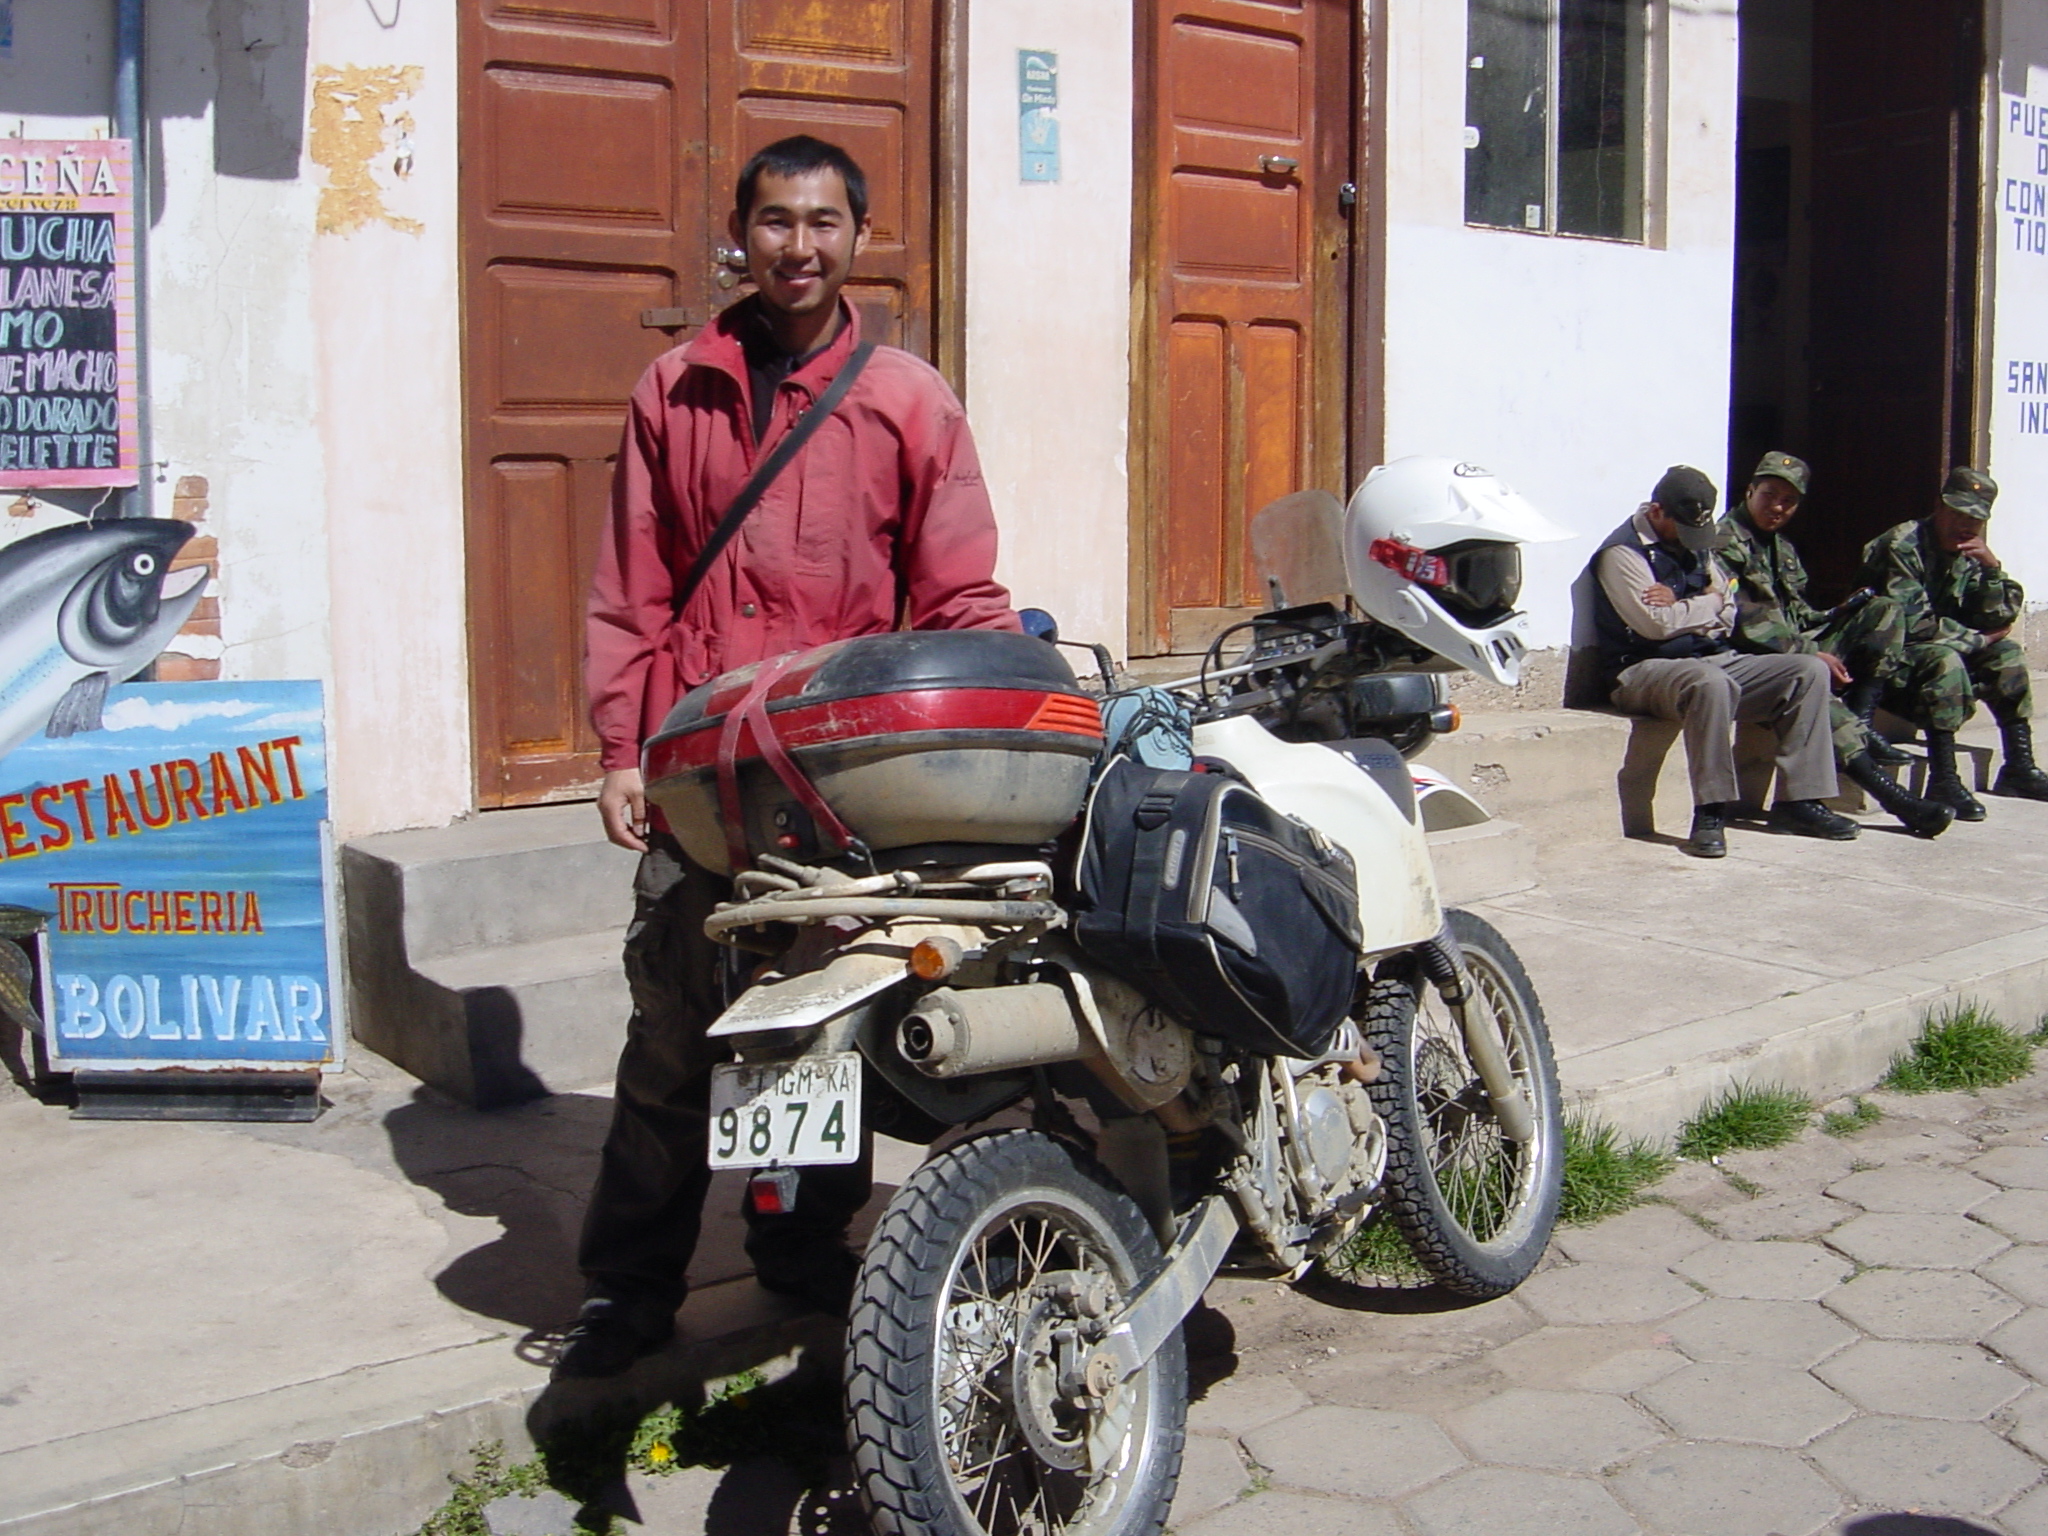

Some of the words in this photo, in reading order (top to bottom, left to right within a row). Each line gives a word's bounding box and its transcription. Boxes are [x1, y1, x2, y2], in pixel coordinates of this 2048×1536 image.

[2005, 178, 2046, 217] CON
[1, 216, 115, 263] UCHA
[0, 310, 64, 348] MO
[26, 349, 118, 393] MACHO
[2008, 360, 2048, 394] SAN
[17, 395, 119, 434] DORADO
[0, 735, 304, 863] ESTAURANT
[48, 882, 264, 934] TRUCHERIA
[56, 973, 326, 1041] BOLIVAR
[717, 1100, 846, 1158] 9874
